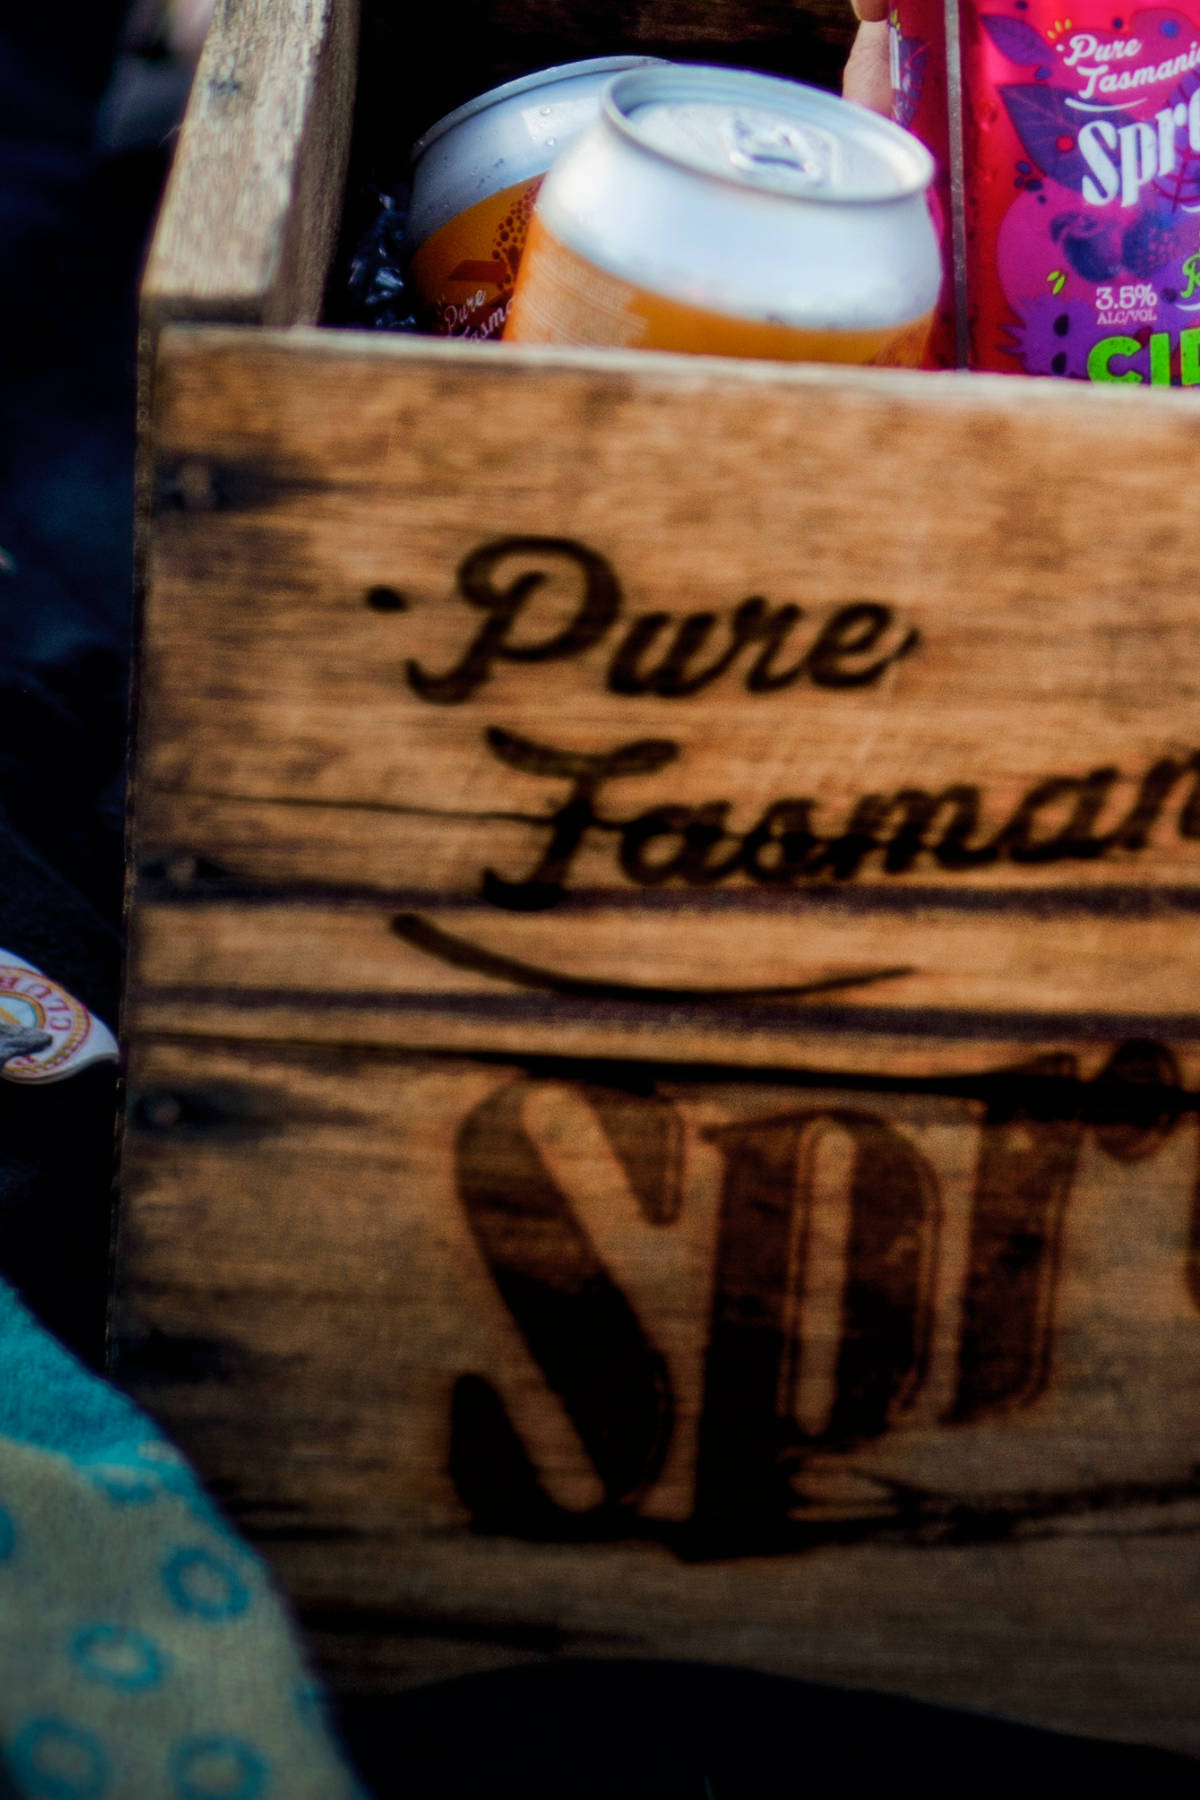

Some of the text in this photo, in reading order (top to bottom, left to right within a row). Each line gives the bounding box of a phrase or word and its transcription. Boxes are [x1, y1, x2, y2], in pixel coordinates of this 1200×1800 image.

[1063, 33, 1143, 67] Pure
[1095, 283, 1158, 311] 3.5%
[1096, 309, 1158, 326] ALC/VOL
[404, 534, 922, 706] Pure
